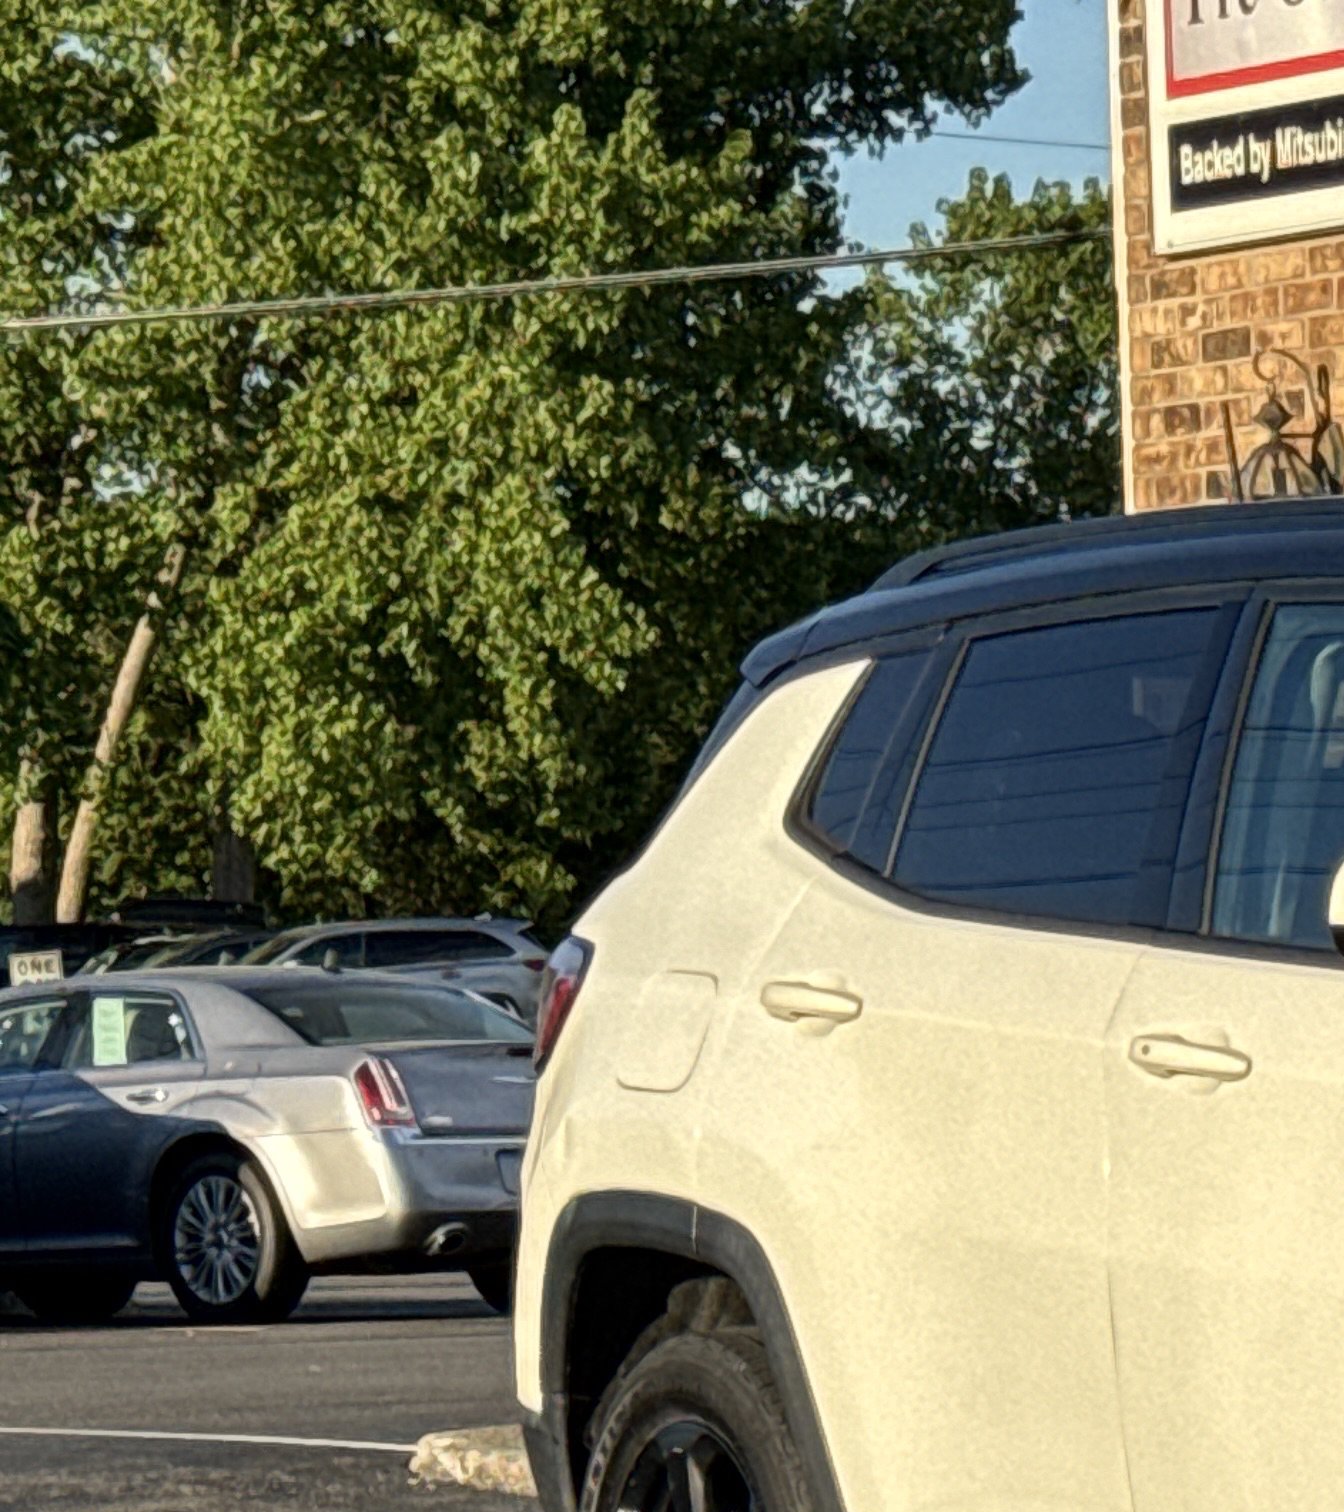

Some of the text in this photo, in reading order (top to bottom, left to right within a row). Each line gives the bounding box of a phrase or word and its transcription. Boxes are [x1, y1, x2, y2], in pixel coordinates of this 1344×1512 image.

[1179, 133, 1245, 186] Backed
[1248, 131, 1272, 184] by
[17, 958, 56, 977] ONE
